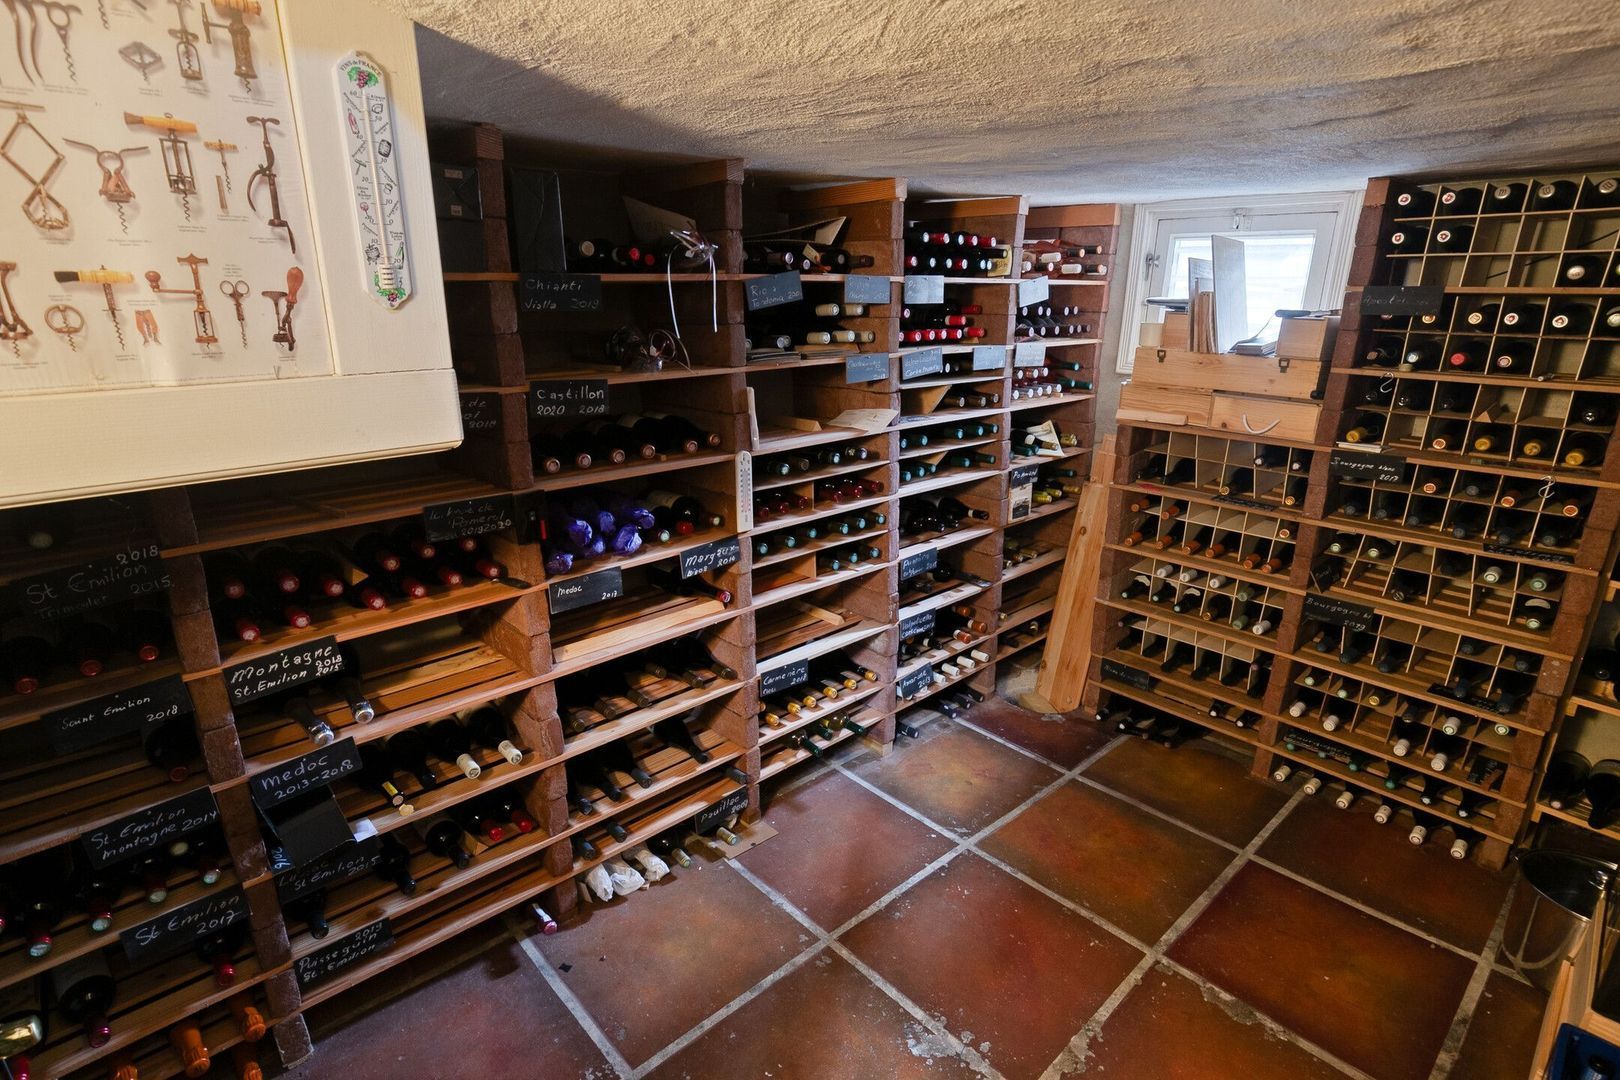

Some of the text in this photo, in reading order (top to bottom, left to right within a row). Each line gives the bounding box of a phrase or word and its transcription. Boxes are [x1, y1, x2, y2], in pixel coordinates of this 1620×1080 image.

[359, 59, 383, 76] FRANCE
[525, 278, 584, 292] Chianti
[536, 385, 605, 400] Castillon
[536, 404, 606, 416] 2020 2018
[116, 545, 160, 566] 2018
[685, 545, 739, 567] Margaux
[26, 563, 148, 605] St Emilion
[315, 654, 343, 669] 2018
[61, 696, 151, 730] Saint Emilion
[146, 704, 179, 722] 2018
[119, 807, 186, 839] Emilion
[310, 855, 365, 884] Emilion
[135, 895, 240, 946] St Emilion
[196, 909, 243, 935] 2017
[327, 943, 377, 971] Emilion
